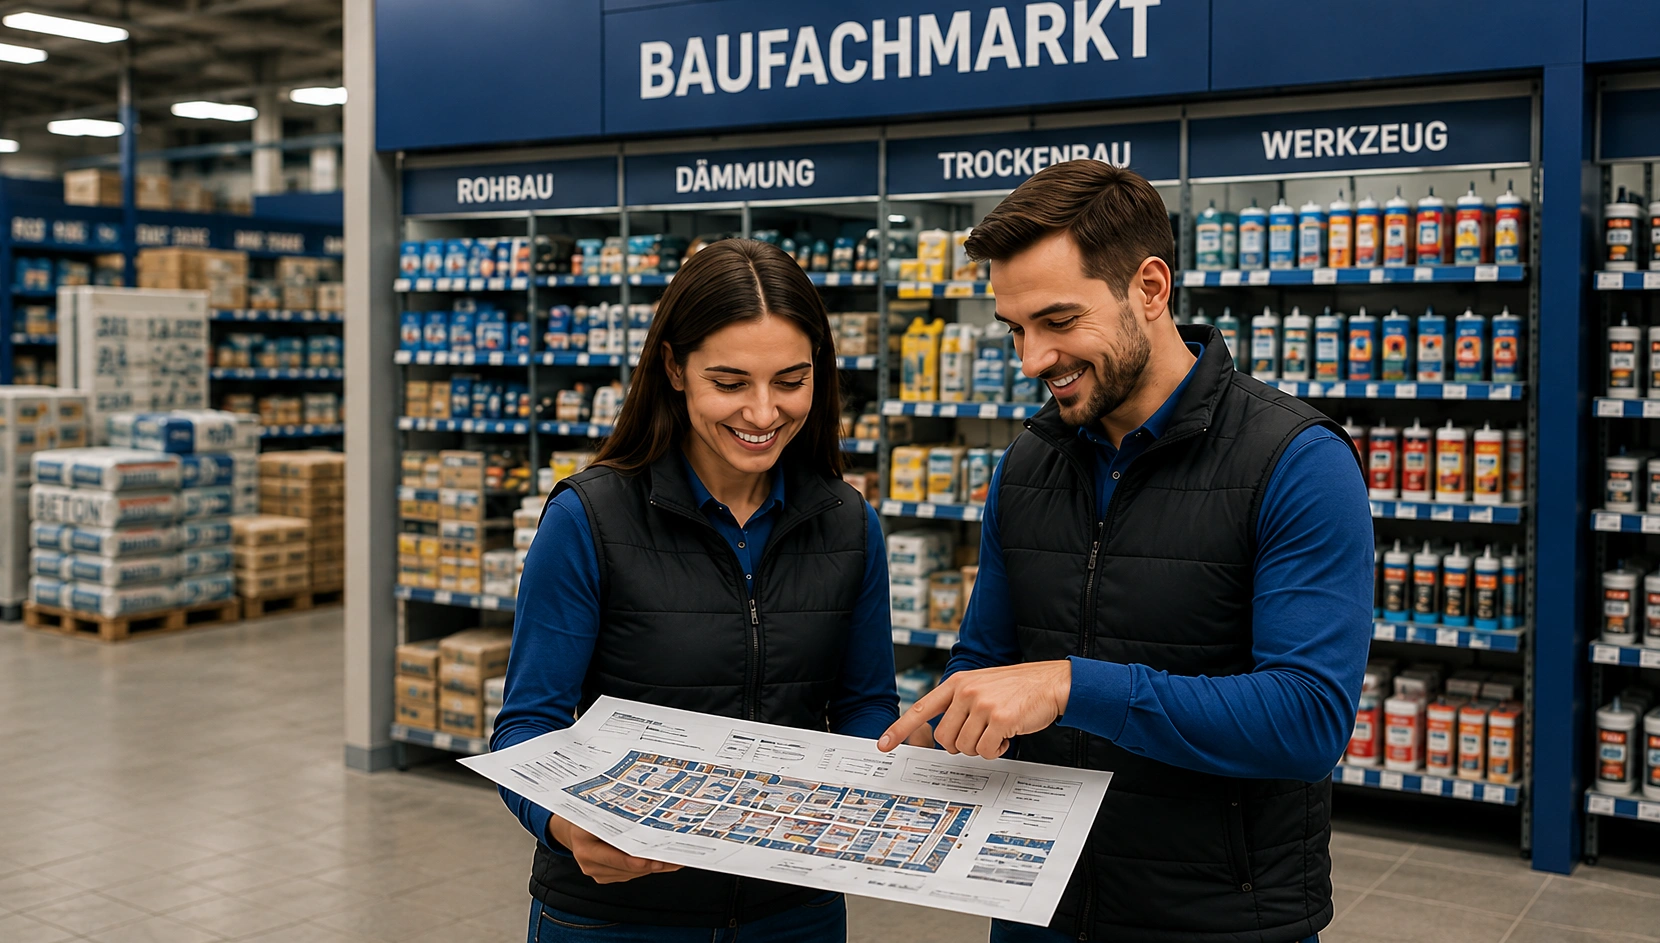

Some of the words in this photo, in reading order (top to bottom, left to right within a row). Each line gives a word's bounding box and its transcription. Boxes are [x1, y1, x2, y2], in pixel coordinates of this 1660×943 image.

[640, 0, 1162, 99] BAUFACHMARKT
[1261, 120, 1448, 161] WERKZEUG
[457, 173, 554, 204] ROHBAU
[675, 159, 815, 193] DÄMMUNG
